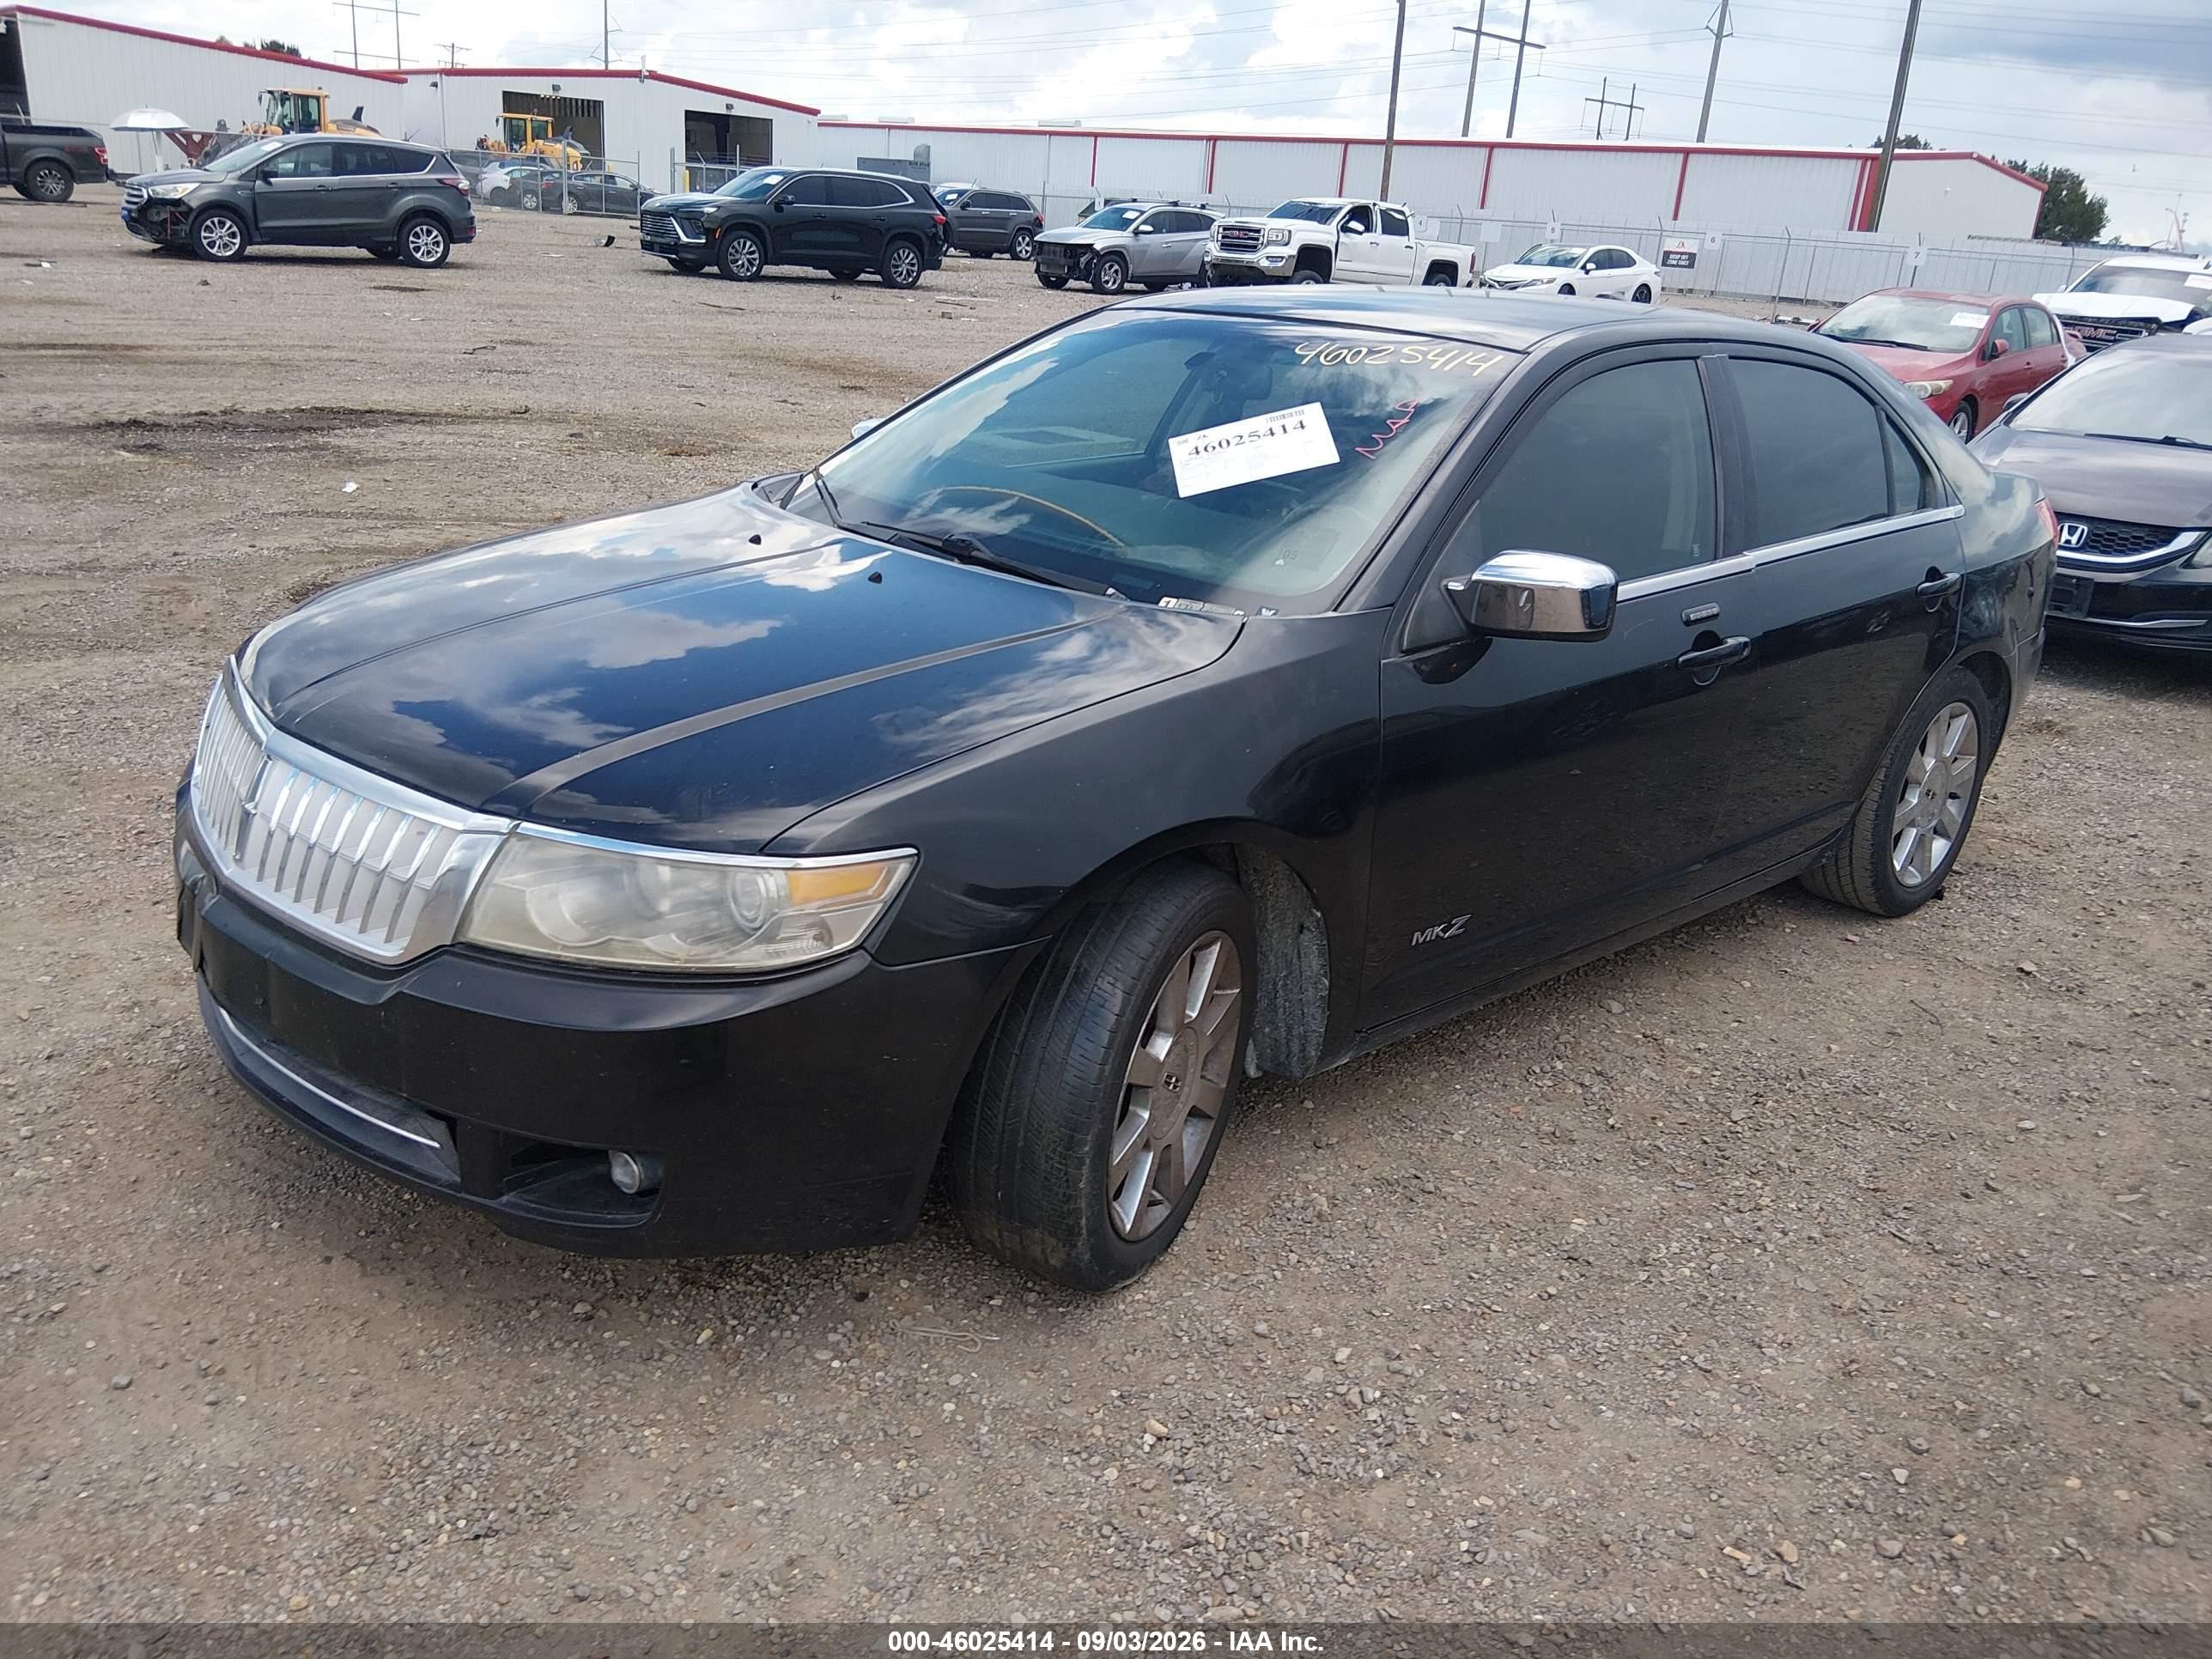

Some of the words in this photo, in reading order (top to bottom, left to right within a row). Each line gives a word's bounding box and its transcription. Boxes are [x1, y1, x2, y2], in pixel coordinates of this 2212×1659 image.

[2075, 325, 2118, 340] GMC
[1188, 419, 1307, 456] 46025414
[1411, 915, 1472, 946] MKZ
